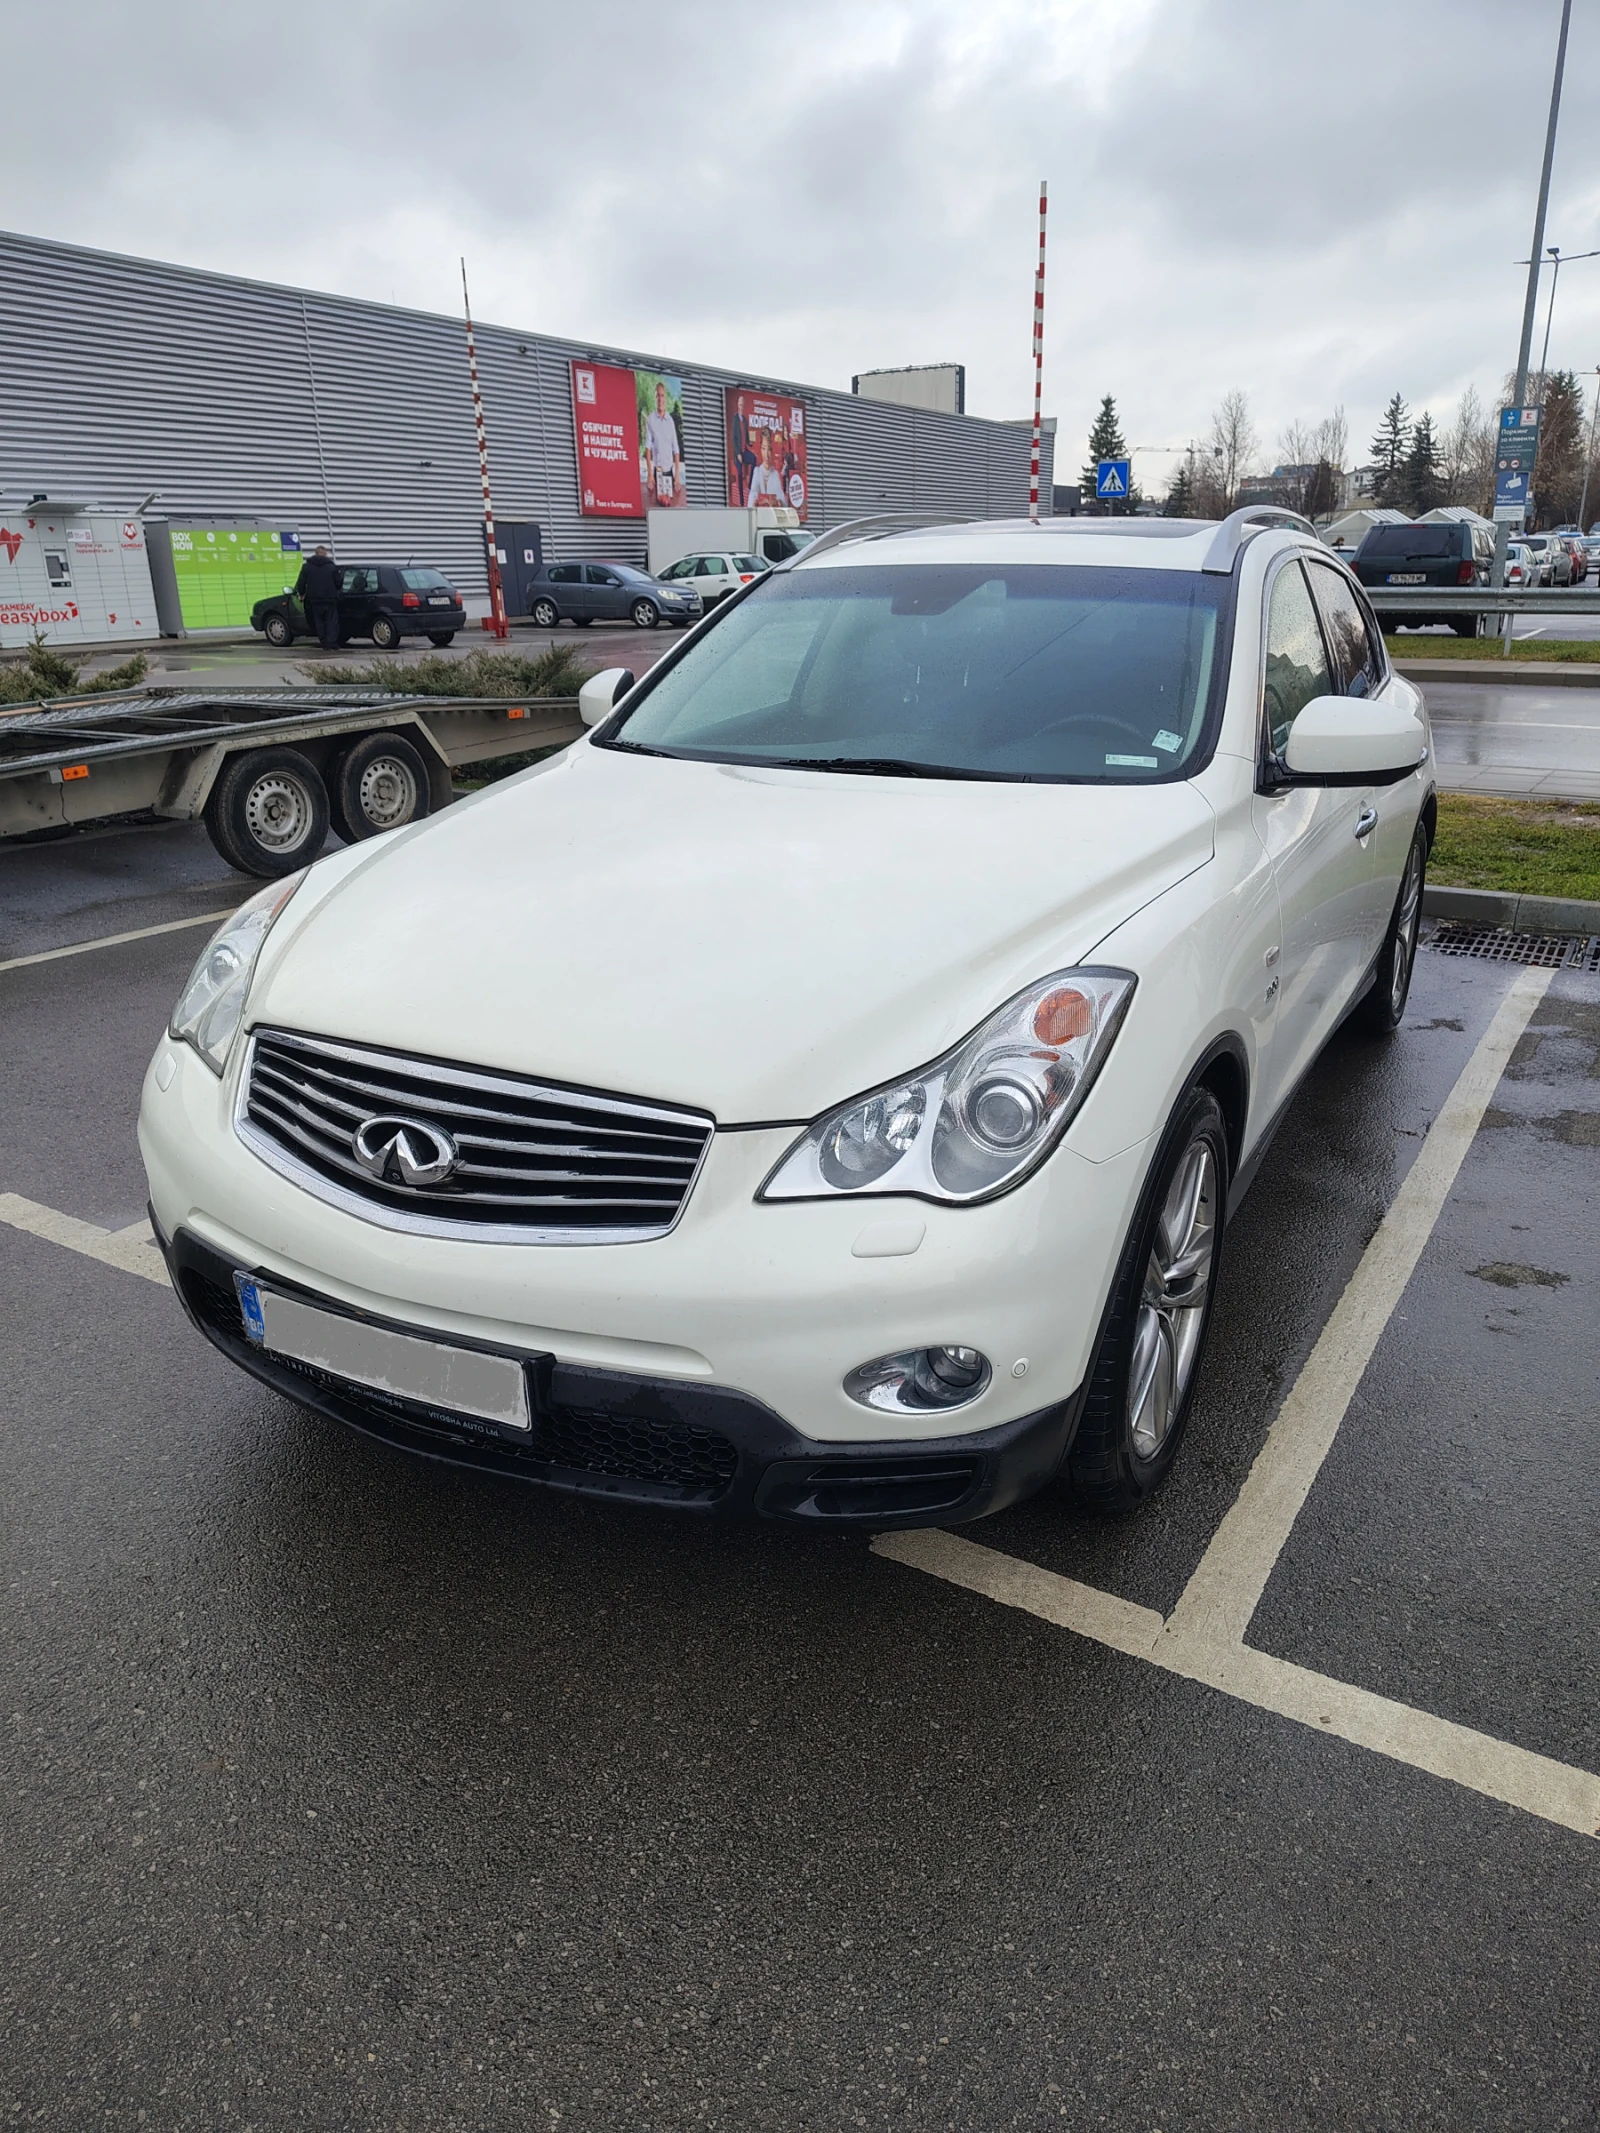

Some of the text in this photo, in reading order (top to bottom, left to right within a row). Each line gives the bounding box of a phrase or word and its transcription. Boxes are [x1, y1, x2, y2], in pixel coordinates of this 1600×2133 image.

[582, 421, 612, 434] ОБИЧАТ
[171, 532, 191, 541] BOX
[173, 541, 193, 551] NOW
[0, 603, 35, 612] SAMEDAY
[0, 607, 70, 625] easybox
[249, 1318, 265, 1336] BG
[428, 1410, 500, 1438] VITOSHA AUTO Ltd
